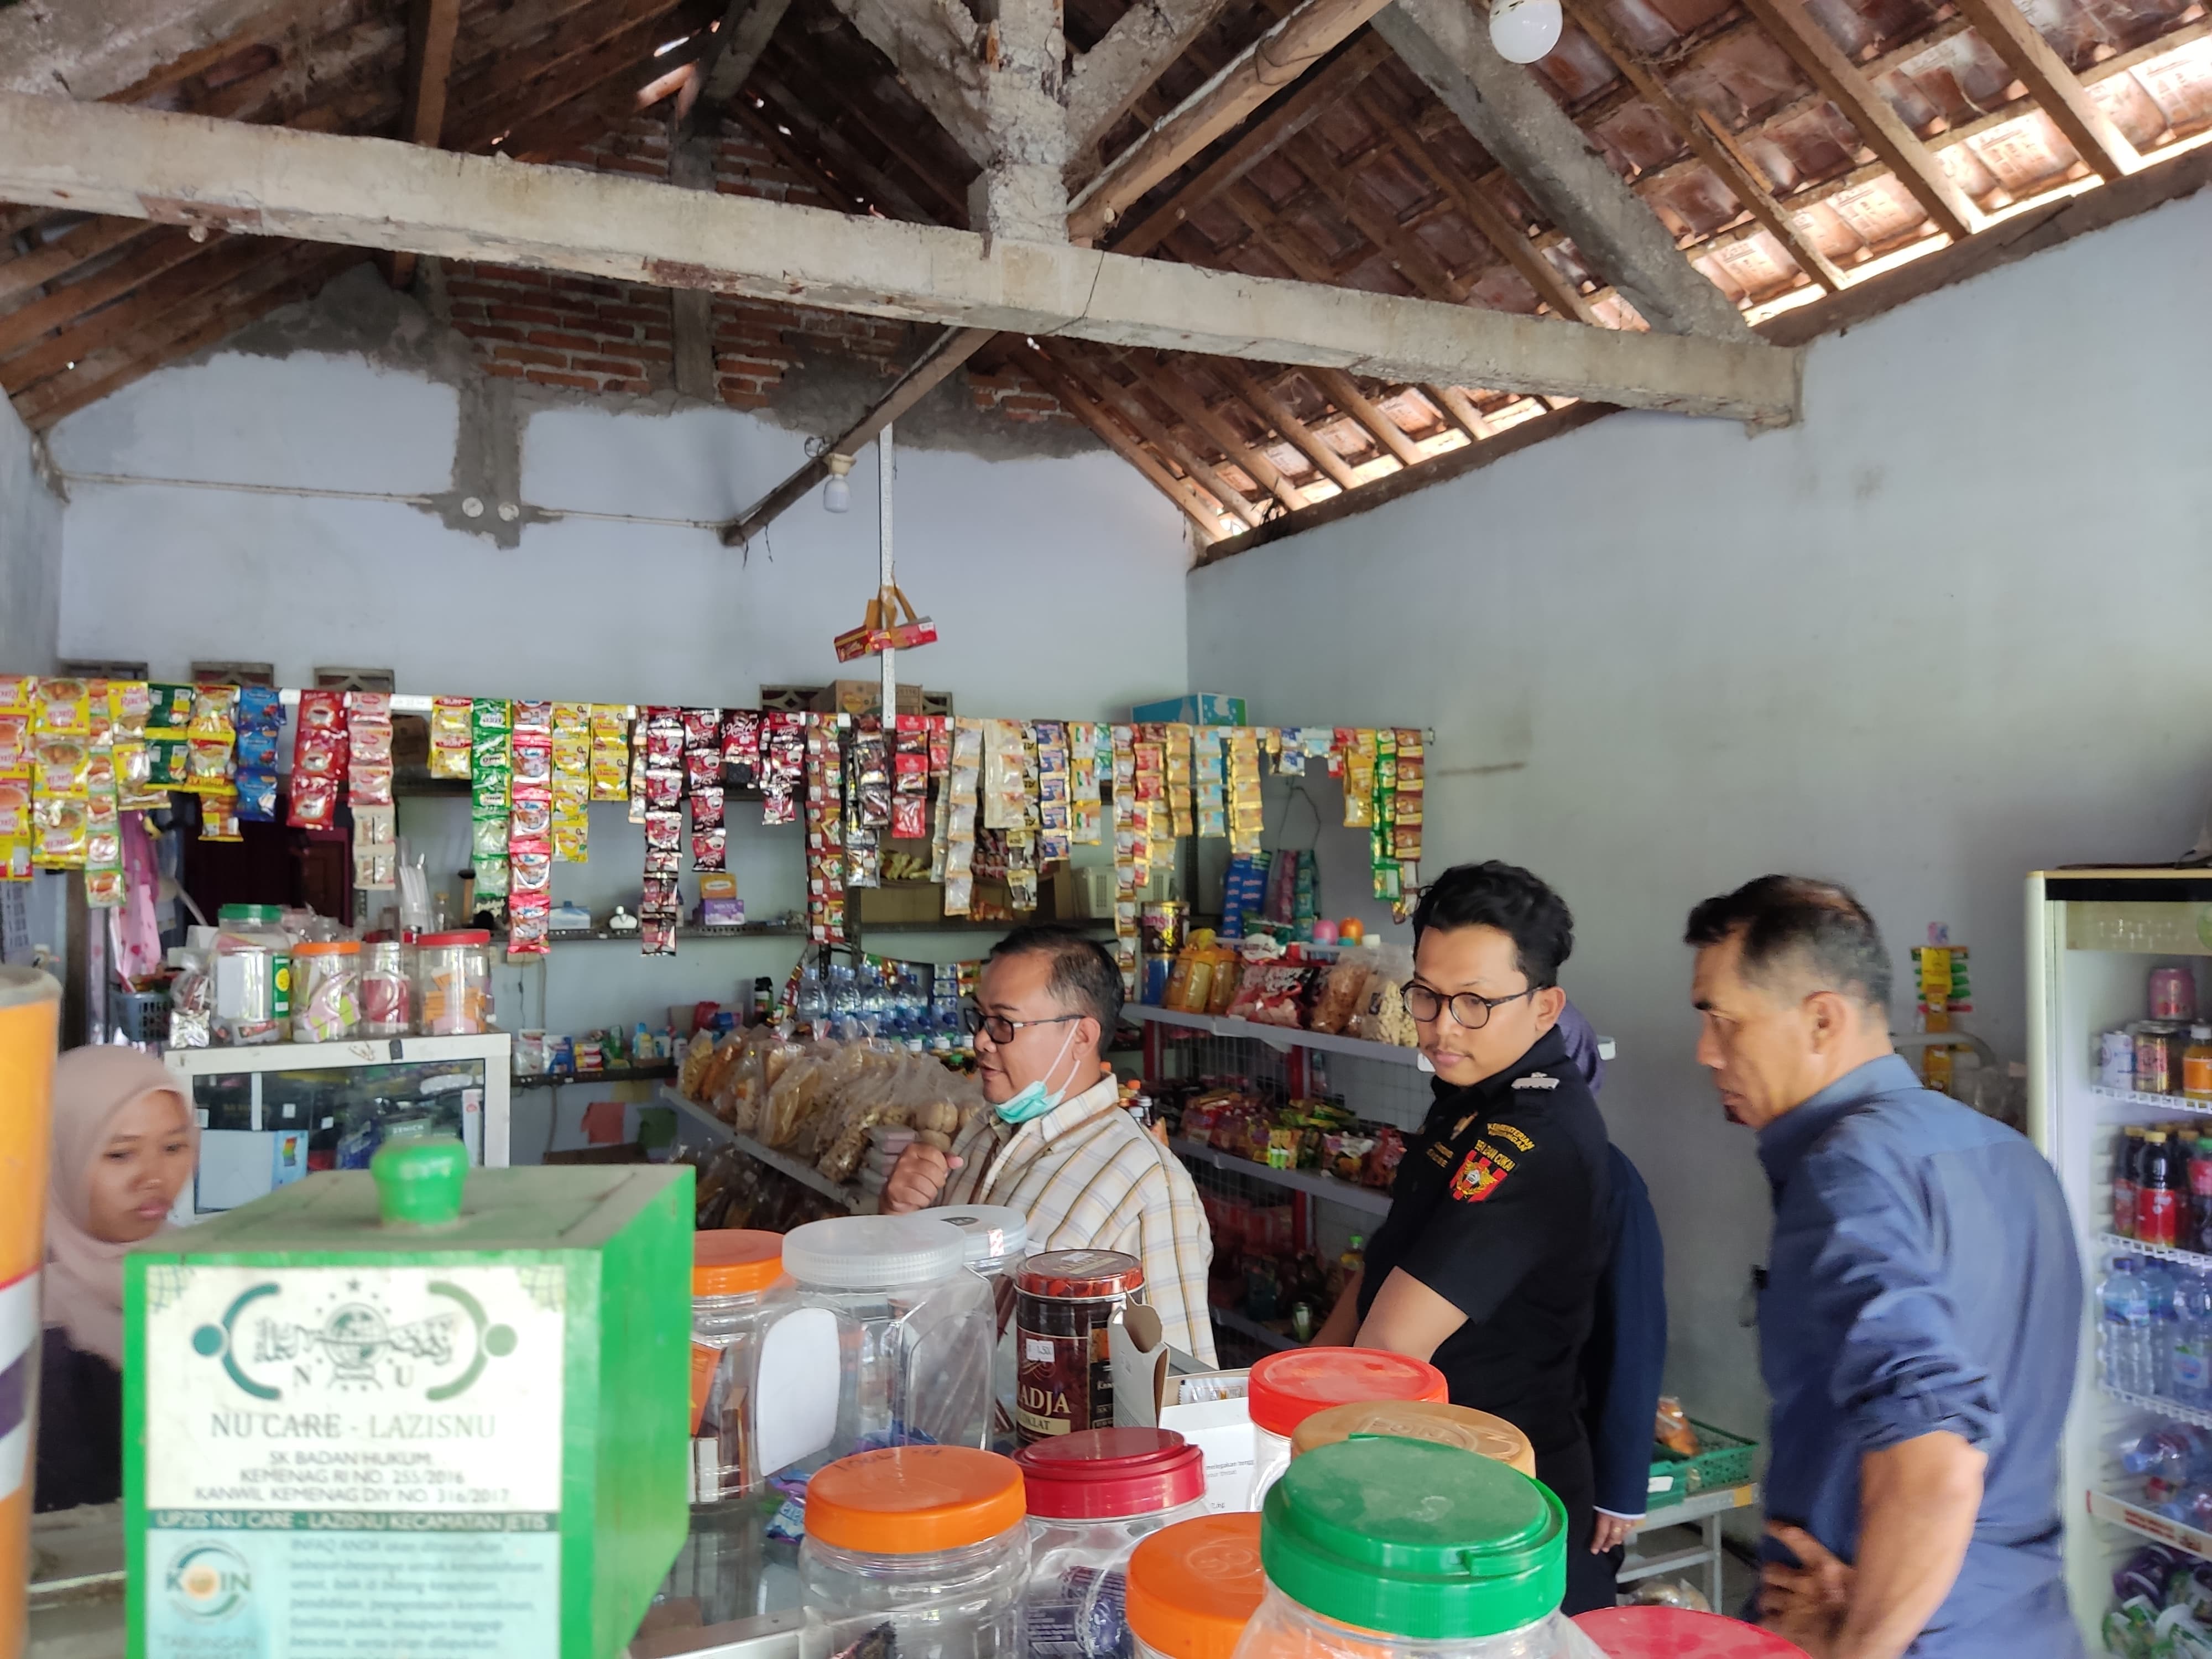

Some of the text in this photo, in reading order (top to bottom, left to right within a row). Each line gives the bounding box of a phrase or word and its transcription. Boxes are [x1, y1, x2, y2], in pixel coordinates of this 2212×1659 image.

[210, 1412, 253, 1439] NU
[261, 1413, 342, 1439] CARE
[368, 1413, 497, 1439] LAZISNU
[269, 1450, 289, 1465] SK
[294, 1450, 357, 1465] BADAN
